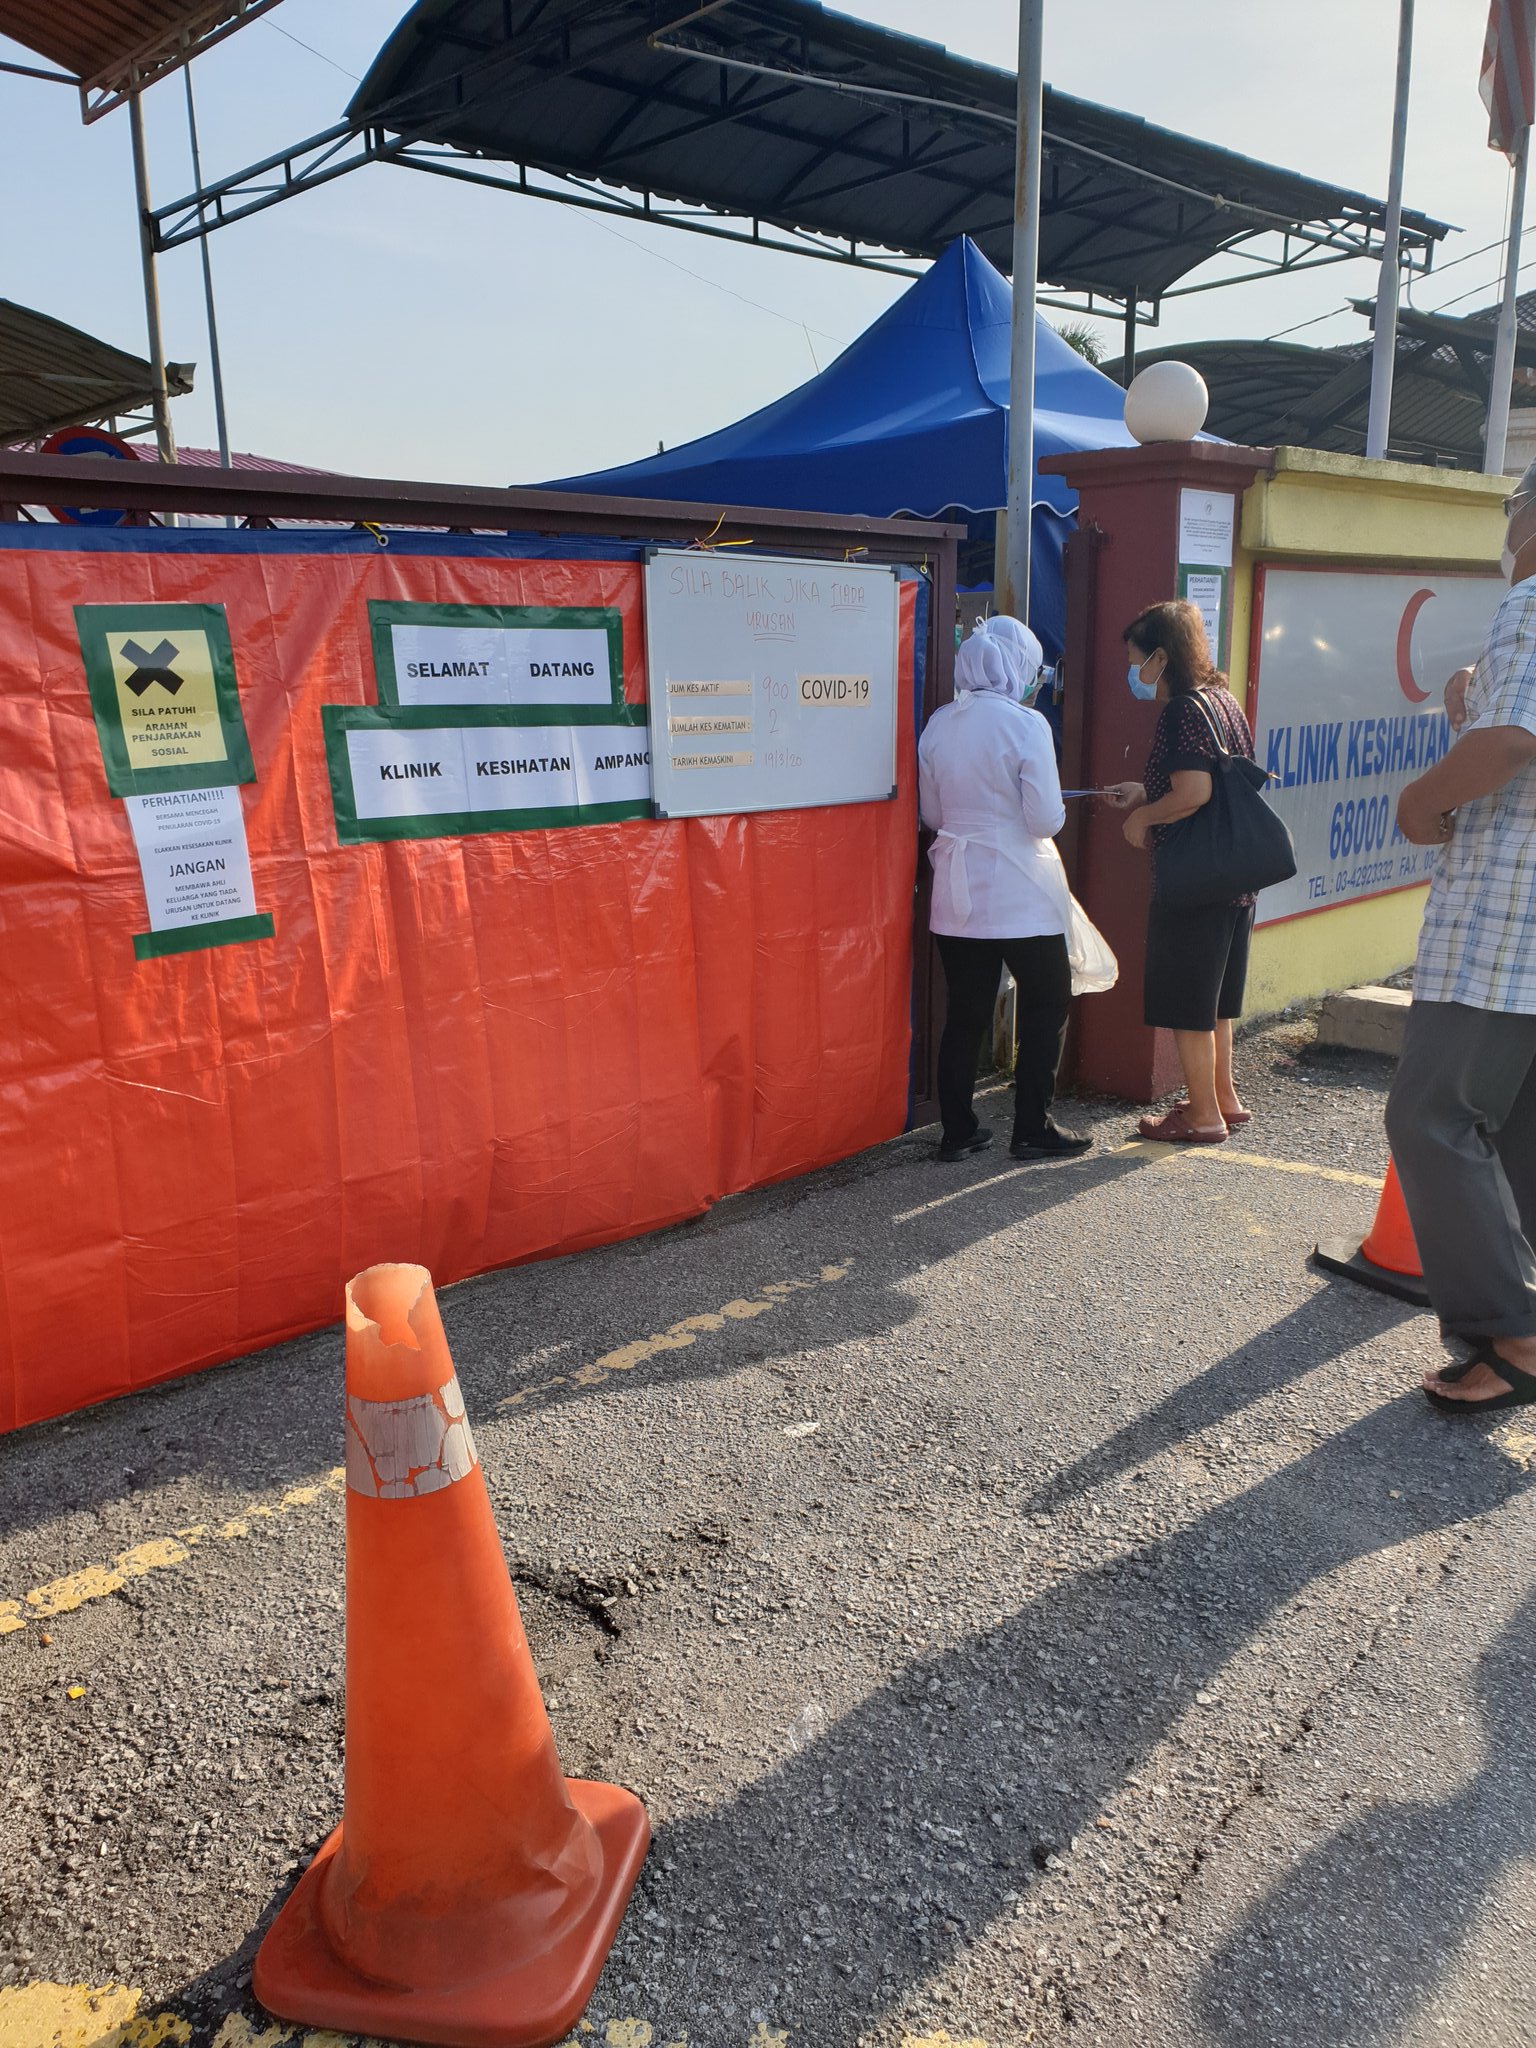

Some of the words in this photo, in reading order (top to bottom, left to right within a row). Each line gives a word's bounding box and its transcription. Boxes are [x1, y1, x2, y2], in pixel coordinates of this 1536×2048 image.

[670, 566, 712, 597] SILA
[721, 570, 775, 599] BALIK
[783, 577, 820, 604] JIKA
[830, 583, 865, 605] TIADA
[746, 611, 796, 631] URUSAN
[406, 661, 490, 678] SELAMAT
[529, 662, 594, 677] DATANG
[670, 684, 685, 693] JUM
[686, 684, 700, 693] KES
[701, 683, 720, 692] AKTIF
[762, 676, 789, 703] 900
[801, 679, 869, 699] COVID-19
[132, 708, 155, 716] SILA
[158, 706, 196, 715] PATUHI
[145, 722, 188, 731] ARAHAN
[671, 723, 698, 733] JUMLAH
[700, 722, 712, 731] KES
[714, 721, 746, 731] KEMATIAN
[769, 708, 779, 734] 2
[132, 730, 201, 742] PENJARAKAN
[151, 747, 189, 756] SOSIAL
[1265, 722, 1343, 791] KLINIK
[1346, 712, 1450, 779] KESIHATAN
[380, 762, 442, 780] KLINIK
[476, 757, 571, 777] KESIHATAN
[673, 757, 698, 767] TARIKH
[700, 756, 734, 765] KEMASKINI
[142, 790, 225, 808] PERHATIAN!!!!
[156, 812, 184, 820] BERSAMA
[185, 808, 218, 817] MENCEGAH
[158, 822, 193, 831] PENULARAN
[1330, 794, 1389, 860] 68000
[154, 845, 180, 854] ELAKKAN
[182, 841, 214, 850] KESESAKAN
[169, 858, 226, 877] JANGAN
[1308, 876, 1327, 899] TEL
[1400, 854, 1418, 876] FAX
[175, 883, 211, 892] MEMBAWA
[166, 894, 199, 904] KELUARGA
[200, 891, 218, 899] YANG
[219, 888, 238, 896] TIADA
[165, 905, 192, 914] URUSAN
[193, 902, 215, 910] UNTUK
[215, 897, 241, 906] DATANG
[200, 911, 220, 919] KLINIK
